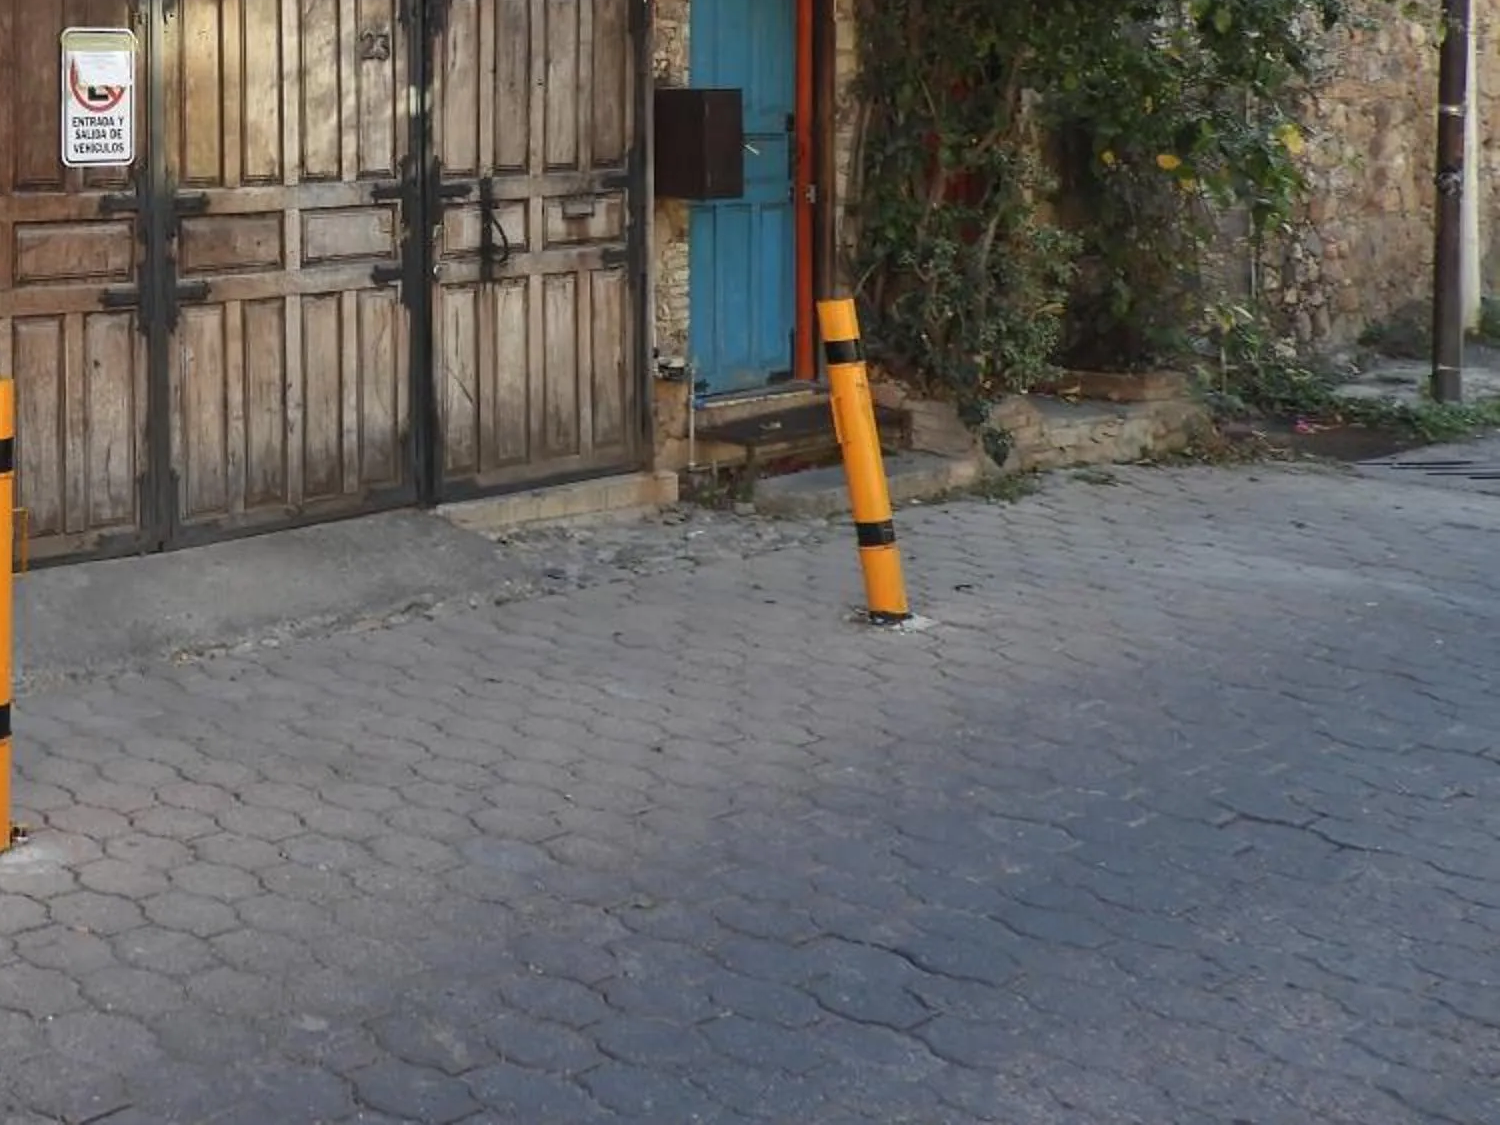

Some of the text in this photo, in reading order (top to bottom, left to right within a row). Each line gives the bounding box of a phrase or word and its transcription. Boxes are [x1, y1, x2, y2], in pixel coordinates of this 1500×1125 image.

[72, 116, 124, 127] ENTRADA Y
[75, 128, 122, 140] SALIDA DE
[73, 142, 124, 154] VEHICULOS
